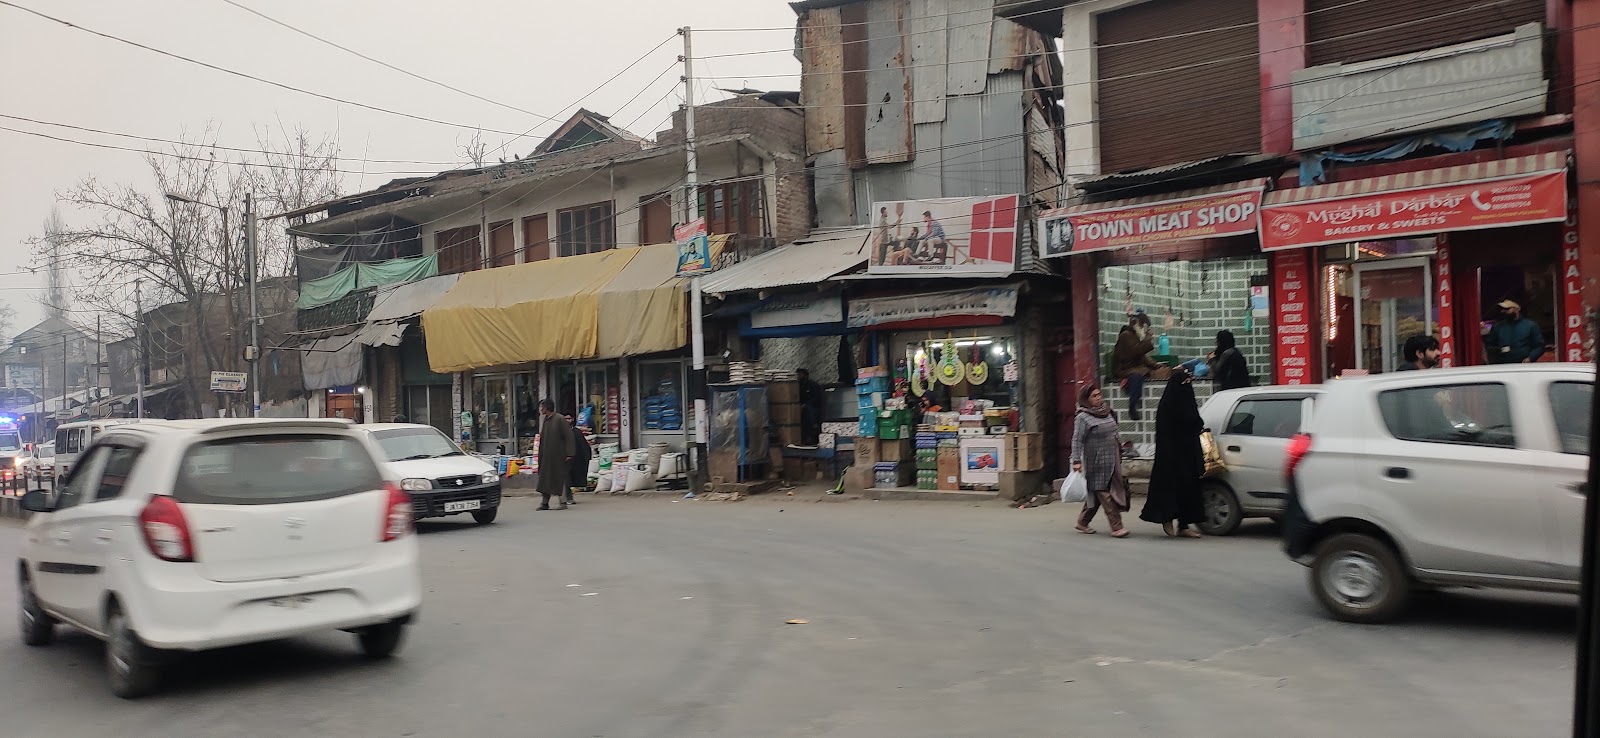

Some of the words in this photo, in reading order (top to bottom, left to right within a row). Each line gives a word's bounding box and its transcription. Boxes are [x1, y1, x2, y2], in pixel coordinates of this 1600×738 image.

[1306, 201, 1383, 225] Mughal
[1389, 193, 1466, 215] Darbar
[1078, 219, 1134, 241] TOWN
[1139, 209, 1193, 234] MEAT
[1197, 202, 1256, 227] SHOP
[1325, 224, 1375, 237] BAKERY
[1377, 222, 1390, 231] &
[1392, 215, 1446, 229] SWEETS
[1286, 270, 1297, 279] ALL
[1287, 292, 1297, 301] OF
